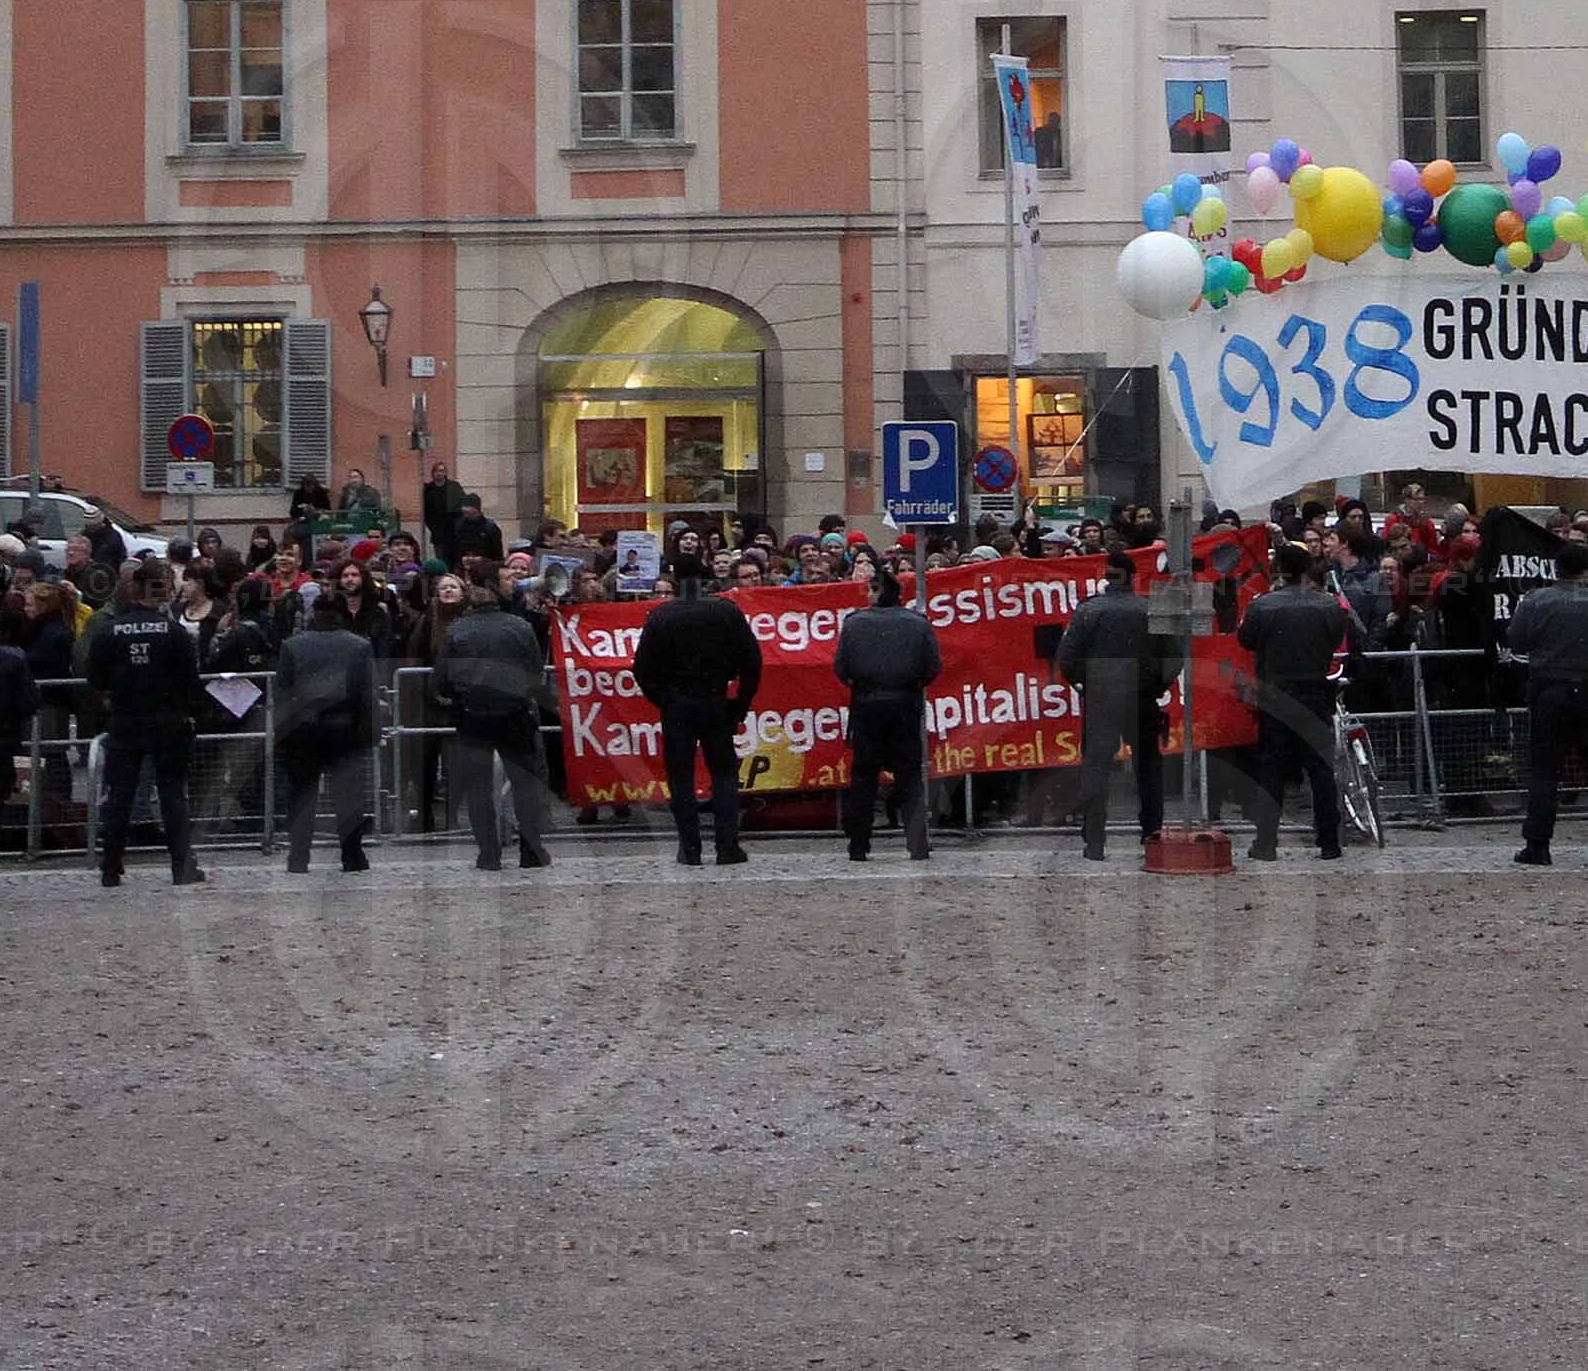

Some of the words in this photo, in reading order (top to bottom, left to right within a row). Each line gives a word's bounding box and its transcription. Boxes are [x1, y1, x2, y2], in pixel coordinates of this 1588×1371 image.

[1169, 304, 1420, 463] 1938
[899, 429, 940, 493] P
[886, 499, 954, 515] Fahrräder
[112, 621, 169, 636] POLIZEI
[129, 642, 151, 655] ST
[556, 613, 644, 658] Kam
[570, 702, 662, 757] Kam
[933, 741, 976, 772] the
[985, 730, 1045, 767] real
